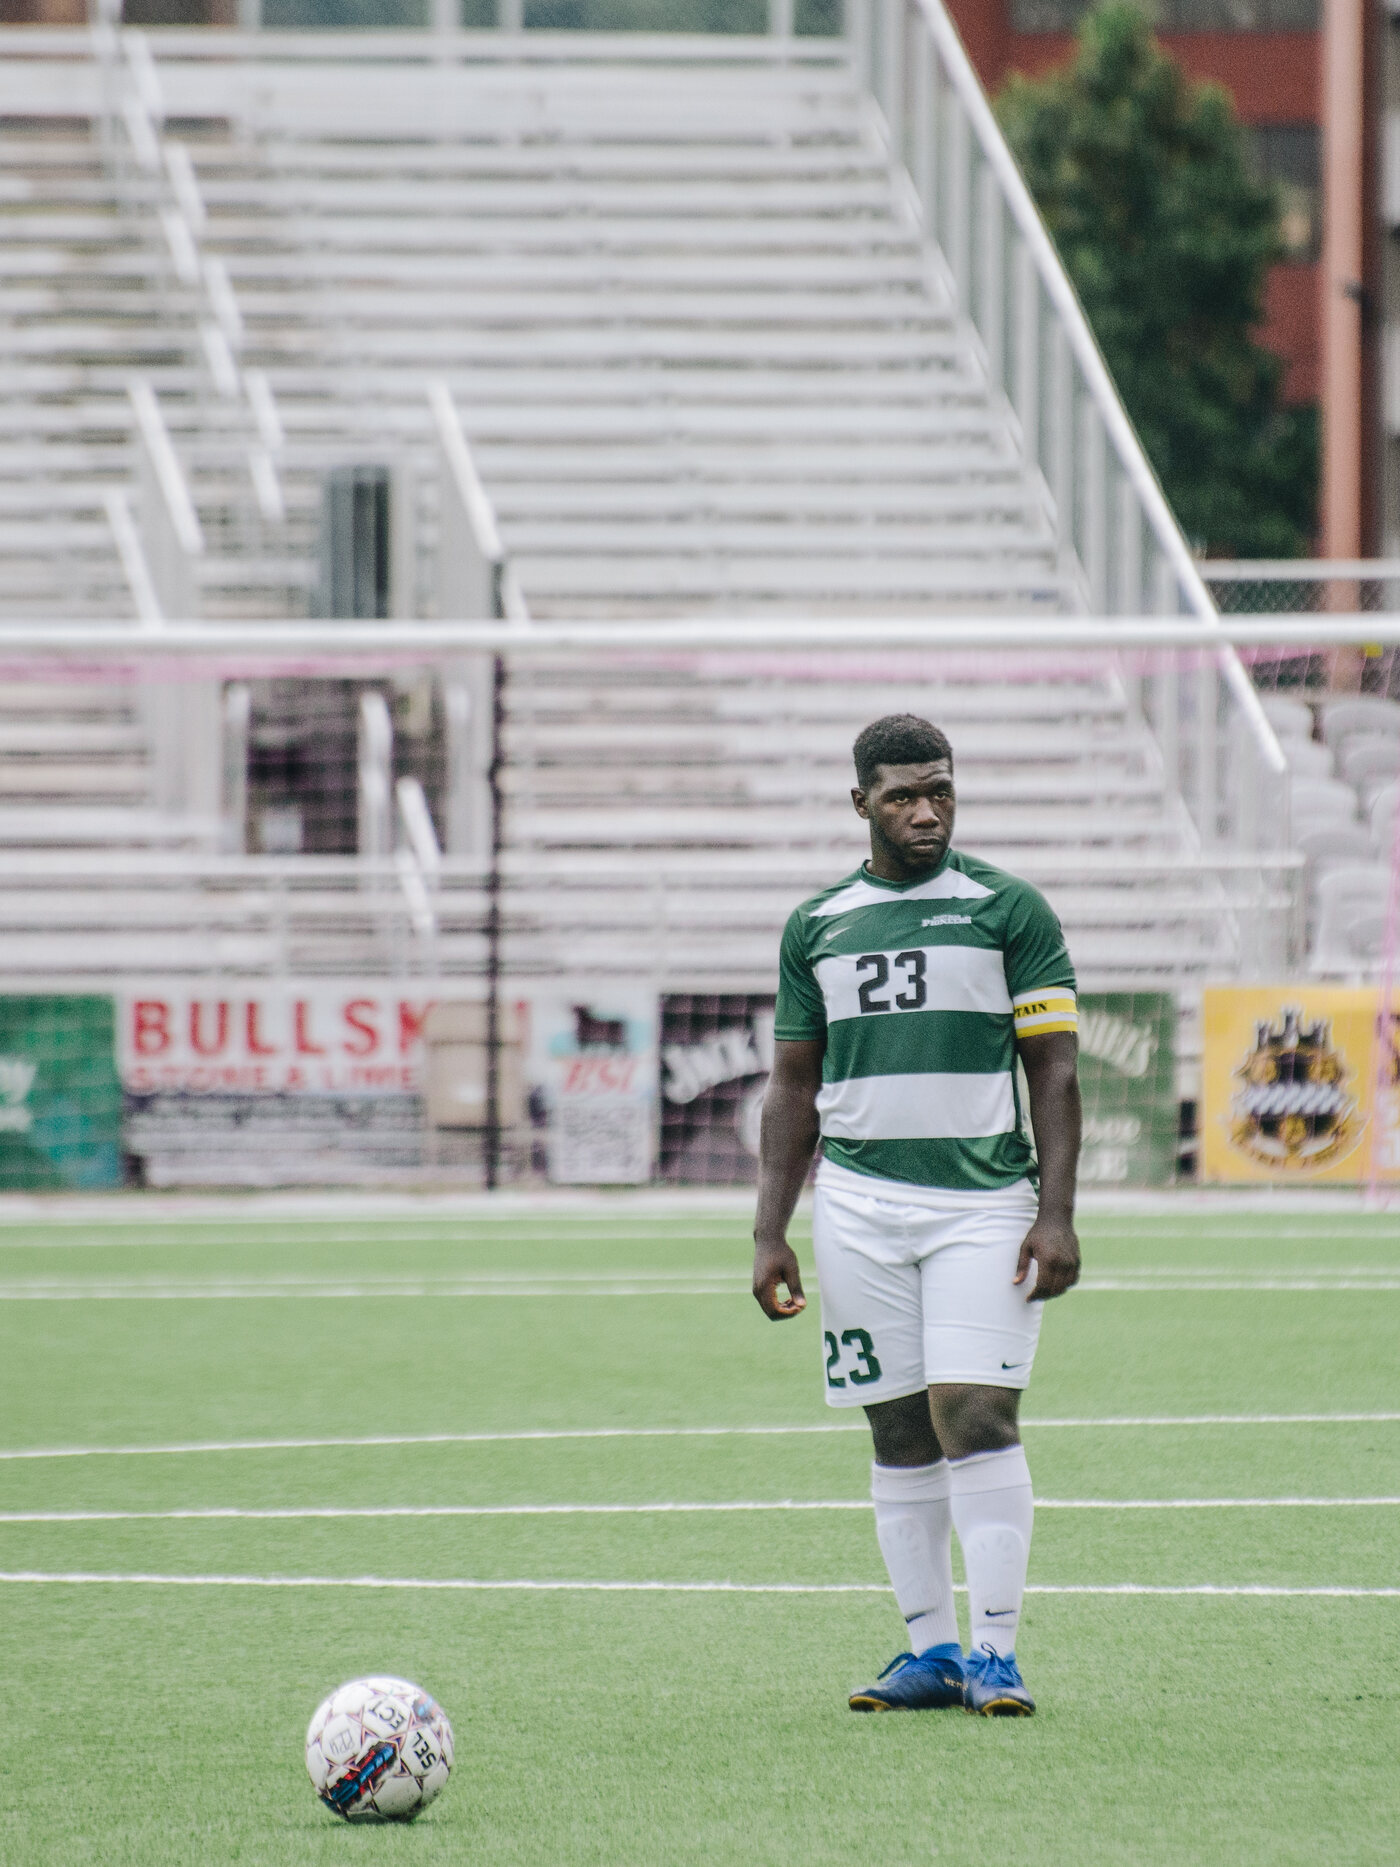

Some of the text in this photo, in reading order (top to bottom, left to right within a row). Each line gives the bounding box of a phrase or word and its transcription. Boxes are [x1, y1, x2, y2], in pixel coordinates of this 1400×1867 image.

[856, 950, 927, 1014] 23
[1014, 1001, 1048, 1017] TAIN
[825, 1328, 882, 1388] 23
